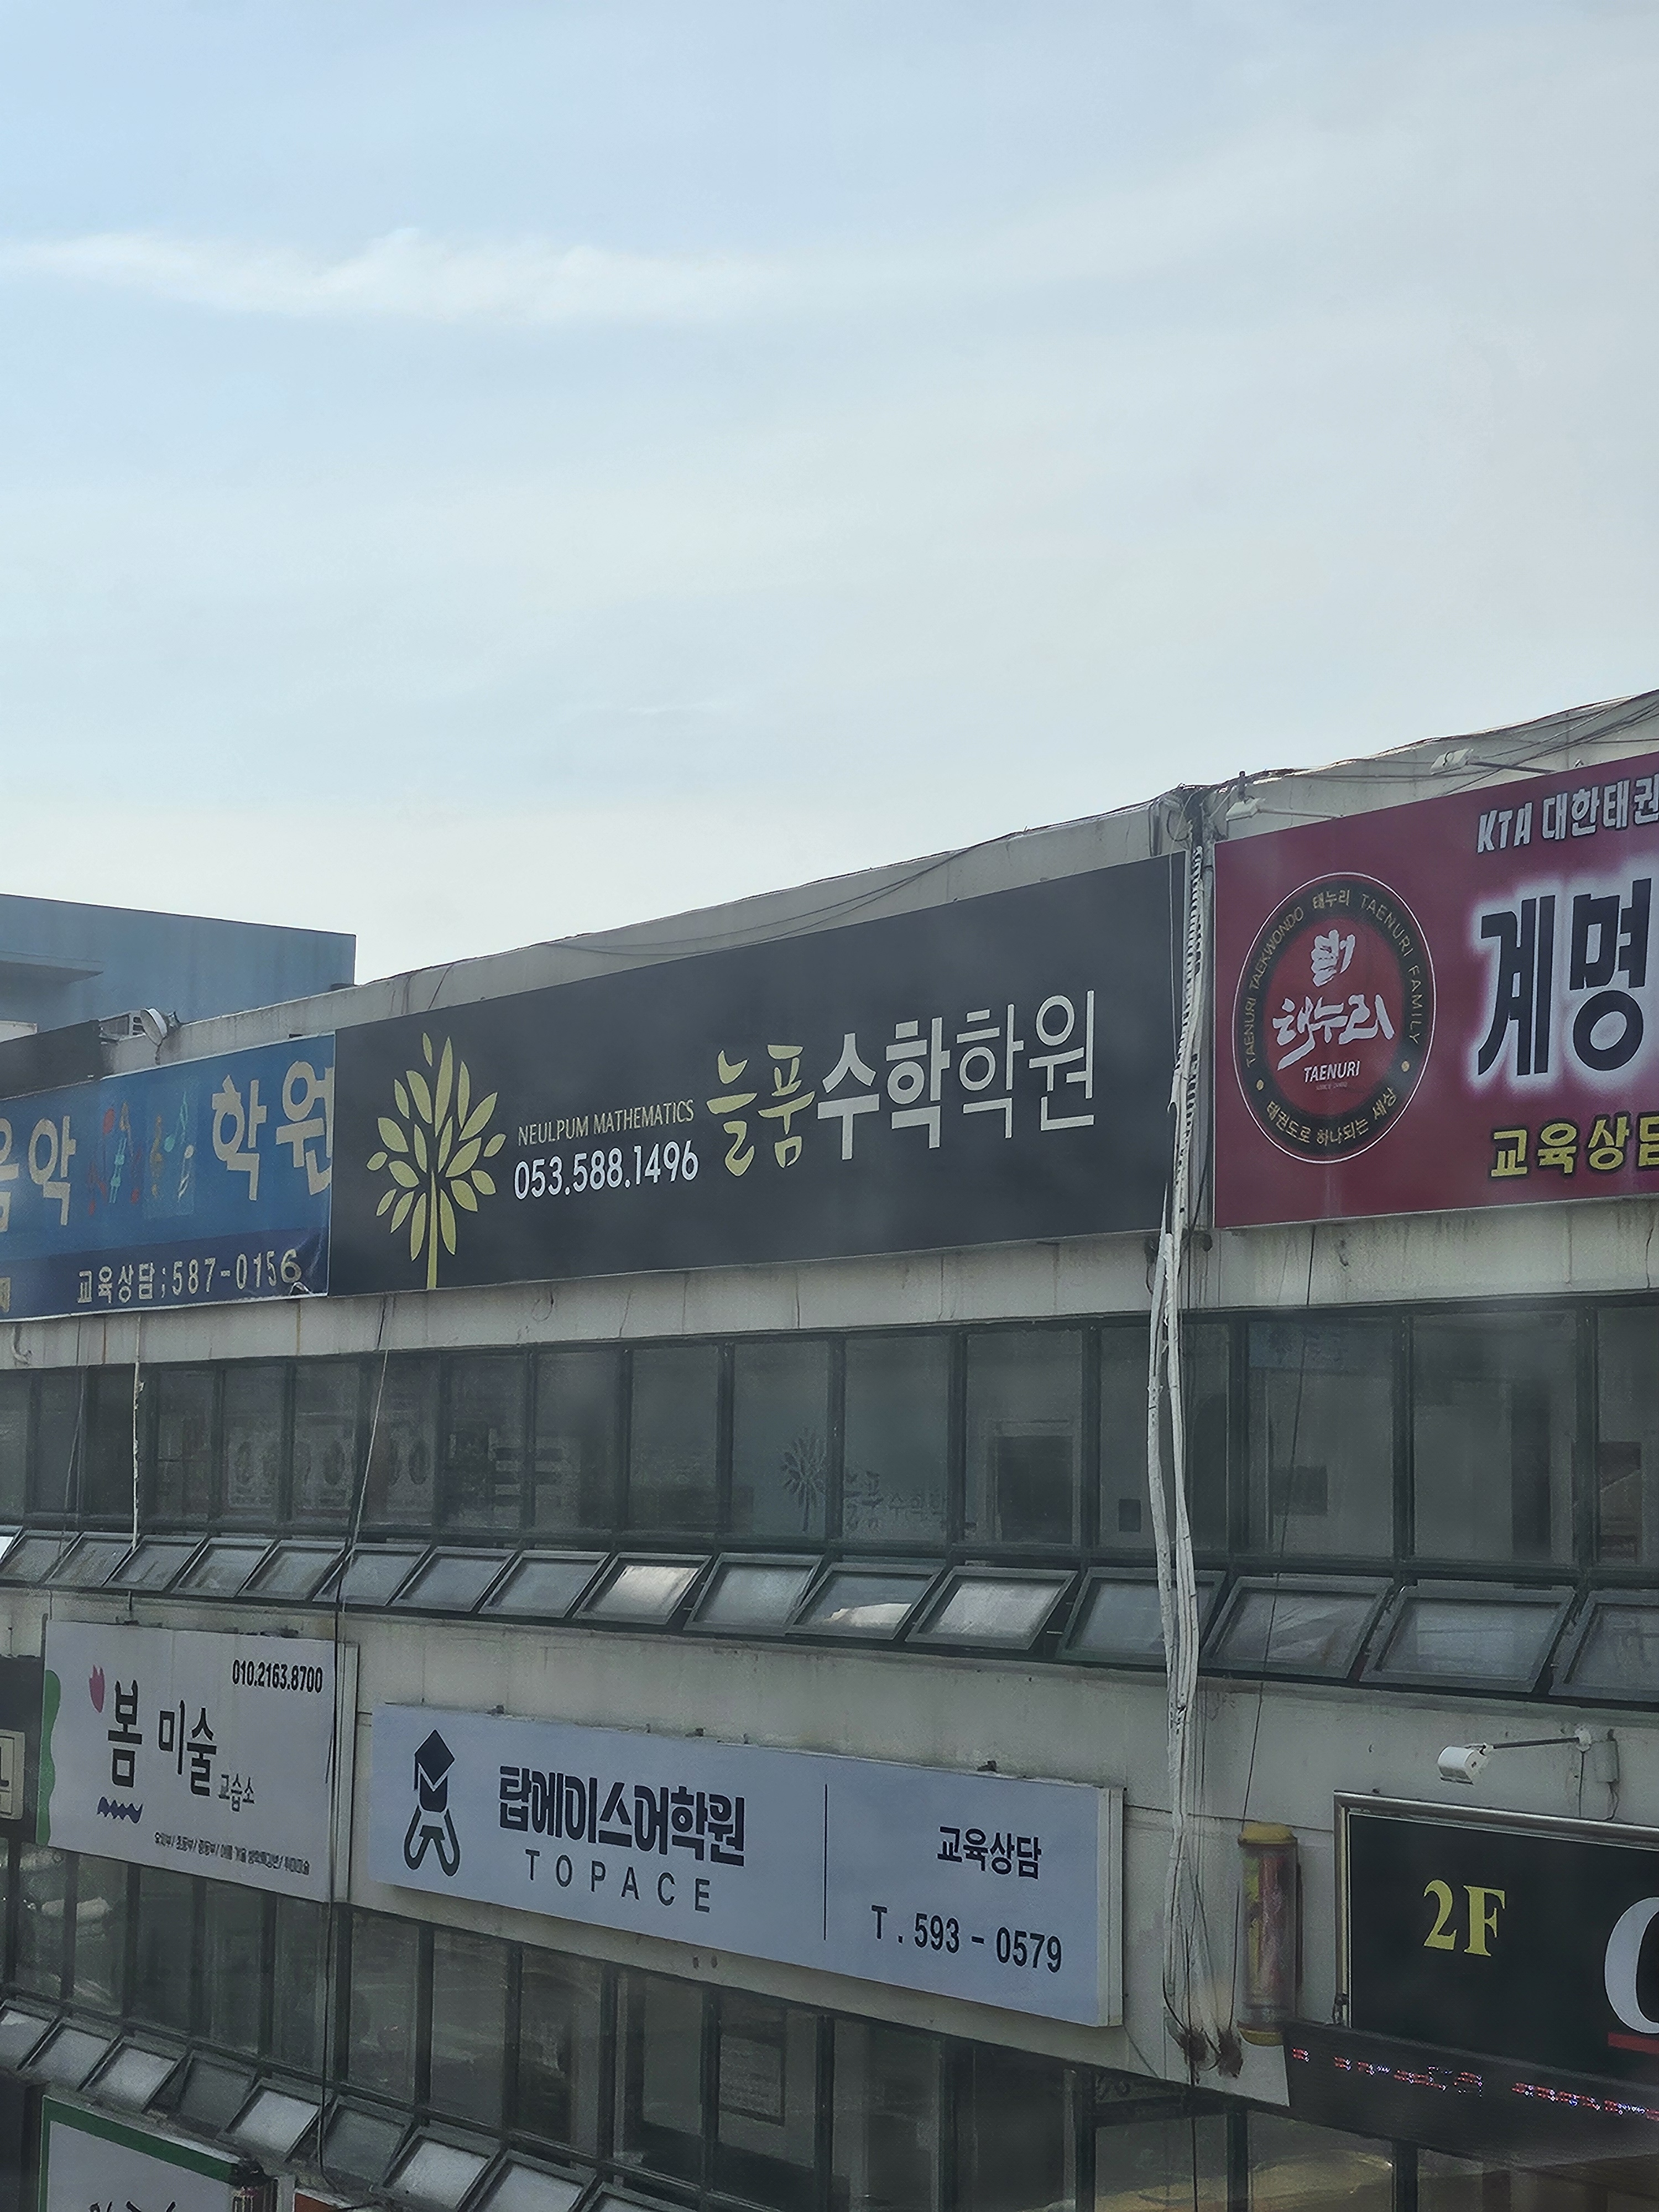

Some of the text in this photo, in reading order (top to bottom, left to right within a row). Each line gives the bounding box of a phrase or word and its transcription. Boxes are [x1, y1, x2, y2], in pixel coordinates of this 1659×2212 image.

[1477, 774, 1659, 853] KTA 대한태권
[1312, 890, 1349, 909] 태누리
[1244, 906, 1304, 1068] TAENURI TAEKWONDO
[1360, 894, 1423, 1044] TAENURI FAMILY
[1478, 878, 1652, 1076] 계명
[1304, 1061, 1360, 1083] TAENURI
[211, 1061, 335, 1201] 학원
[518, 1099, 693, 1146] NEULPUM MATHEMATICS
[1266, 1087, 1397, 1146] 태권도로 하나되는 세상
[514, 1140, 698, 1200] 053.588.1496
[232, 1660, 322, 1693] 010.2163.8700
[108, 1679, 142, 1788] 봄
[158, 1699, 217, 1797] 미술
[218, 1773, 255, 1812] 교습소
[499, 1765, 745, 1867] 탑에이스어학원
[525, 1849, 711, 1913] TOPACE
[937, 1826, 1042, 1880] 교육상담
[1423, 1879, 1505, 1957] 2F
